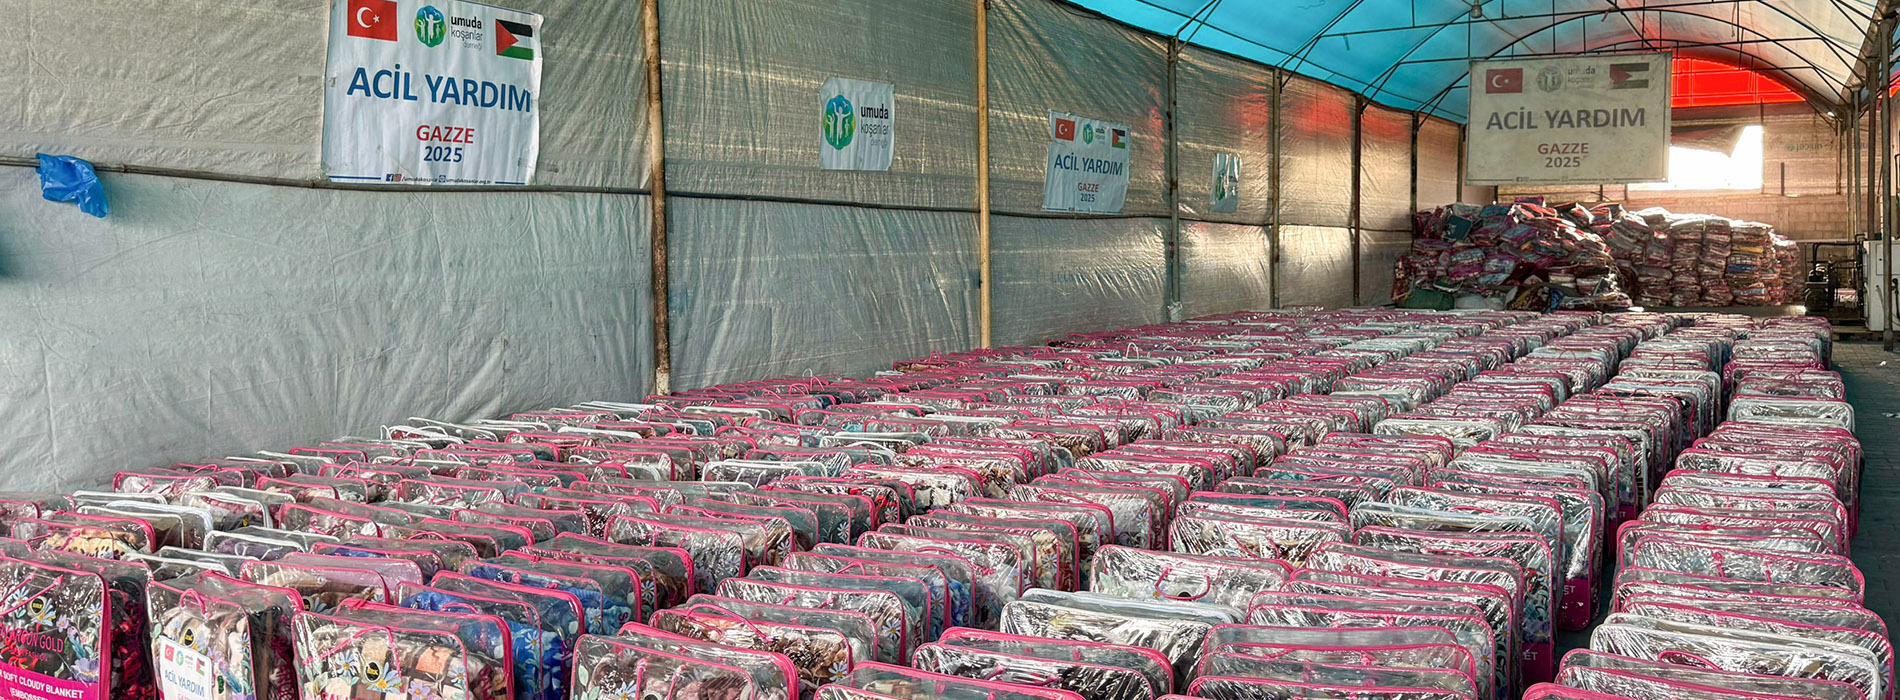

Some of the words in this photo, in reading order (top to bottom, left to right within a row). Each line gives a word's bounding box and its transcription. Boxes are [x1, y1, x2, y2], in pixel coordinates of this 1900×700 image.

[451, 16, 482, 29] umuda
[451, 26, 483, 41] koşanlar
[1568, 66, 1596, 75] uda
[346, 63, 418, 101] ACİL
[424, 74, 532, 113] YARDIM
[860, 103, 889, 119] umuda
[1486, 106, 1538, 130] ACİL
[1544, 107, 1646, 129] YARDIM
[416, 124, 475, 144] GAZZE
[423, 145, 463, 163] 2025
[1537, 142, 1590, 155] GAZZE
[1054, 152, 1079, 171] ACİL
[1082, 157, 1123, 176] YARDIM
[1544, 156, 1581, 168] 2025
[1077, 182, 1099, 192] GAZZE
[1080, 193, 1096, 202] 2025
[40, 634, 64, 653] GOLD
[3, 670, 18, 683] SOFT
[18, 676, 46, 691] CLOUDY
[45, 684, 84, 699] BLANKET
[178, 674, 205, 697] YARDIM
